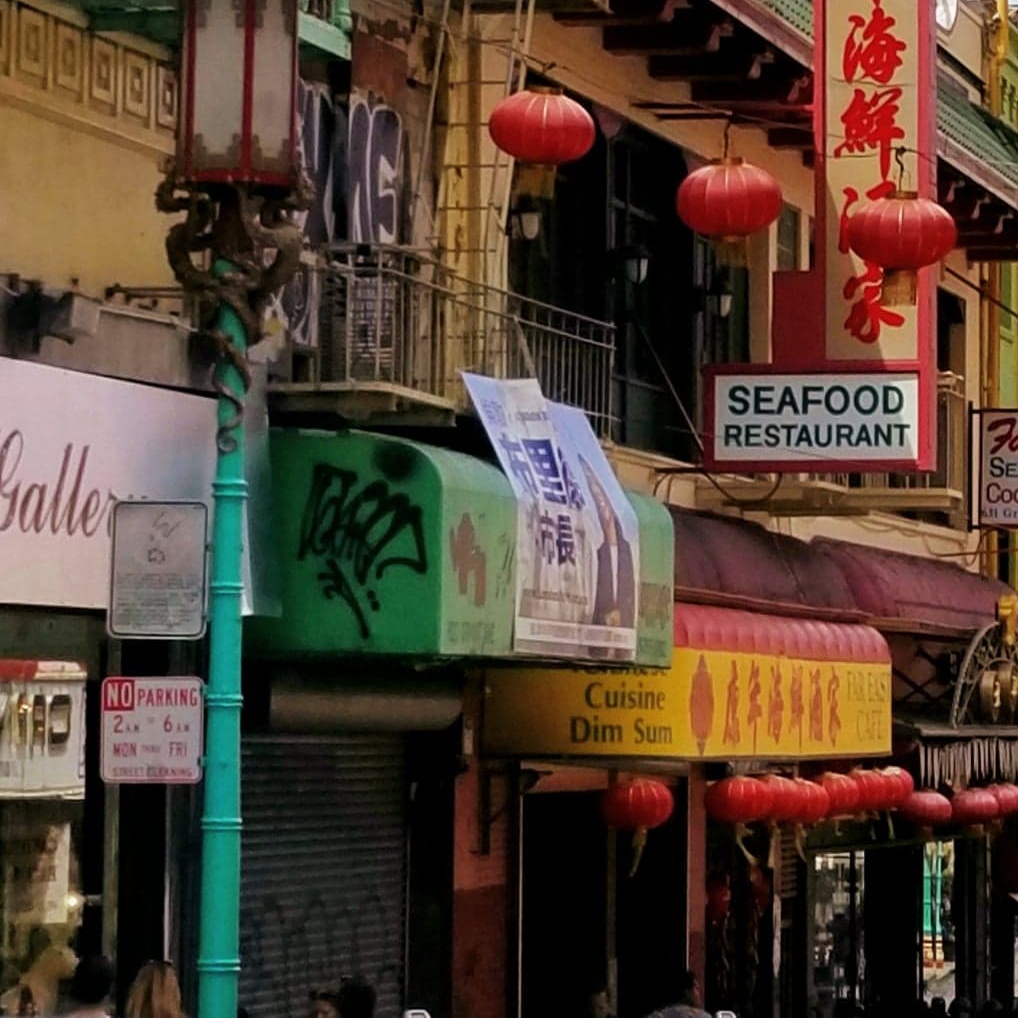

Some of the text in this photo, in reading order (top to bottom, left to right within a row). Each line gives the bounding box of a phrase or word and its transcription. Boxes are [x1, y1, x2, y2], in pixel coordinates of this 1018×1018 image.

[727, 385, 905, 416] SEAFOOD
[723, 423, 910, 447] RESTAURANT
[0, 429, 147, 538] Galler
[106, 682, 198, 708] NO PARKING
[584, 681, 666, 710] Cuisine
[570, 715, 672, 744] Dim Sum
[113, 742, 137, 758] MON
[168, 742, 188, 758] FRI
